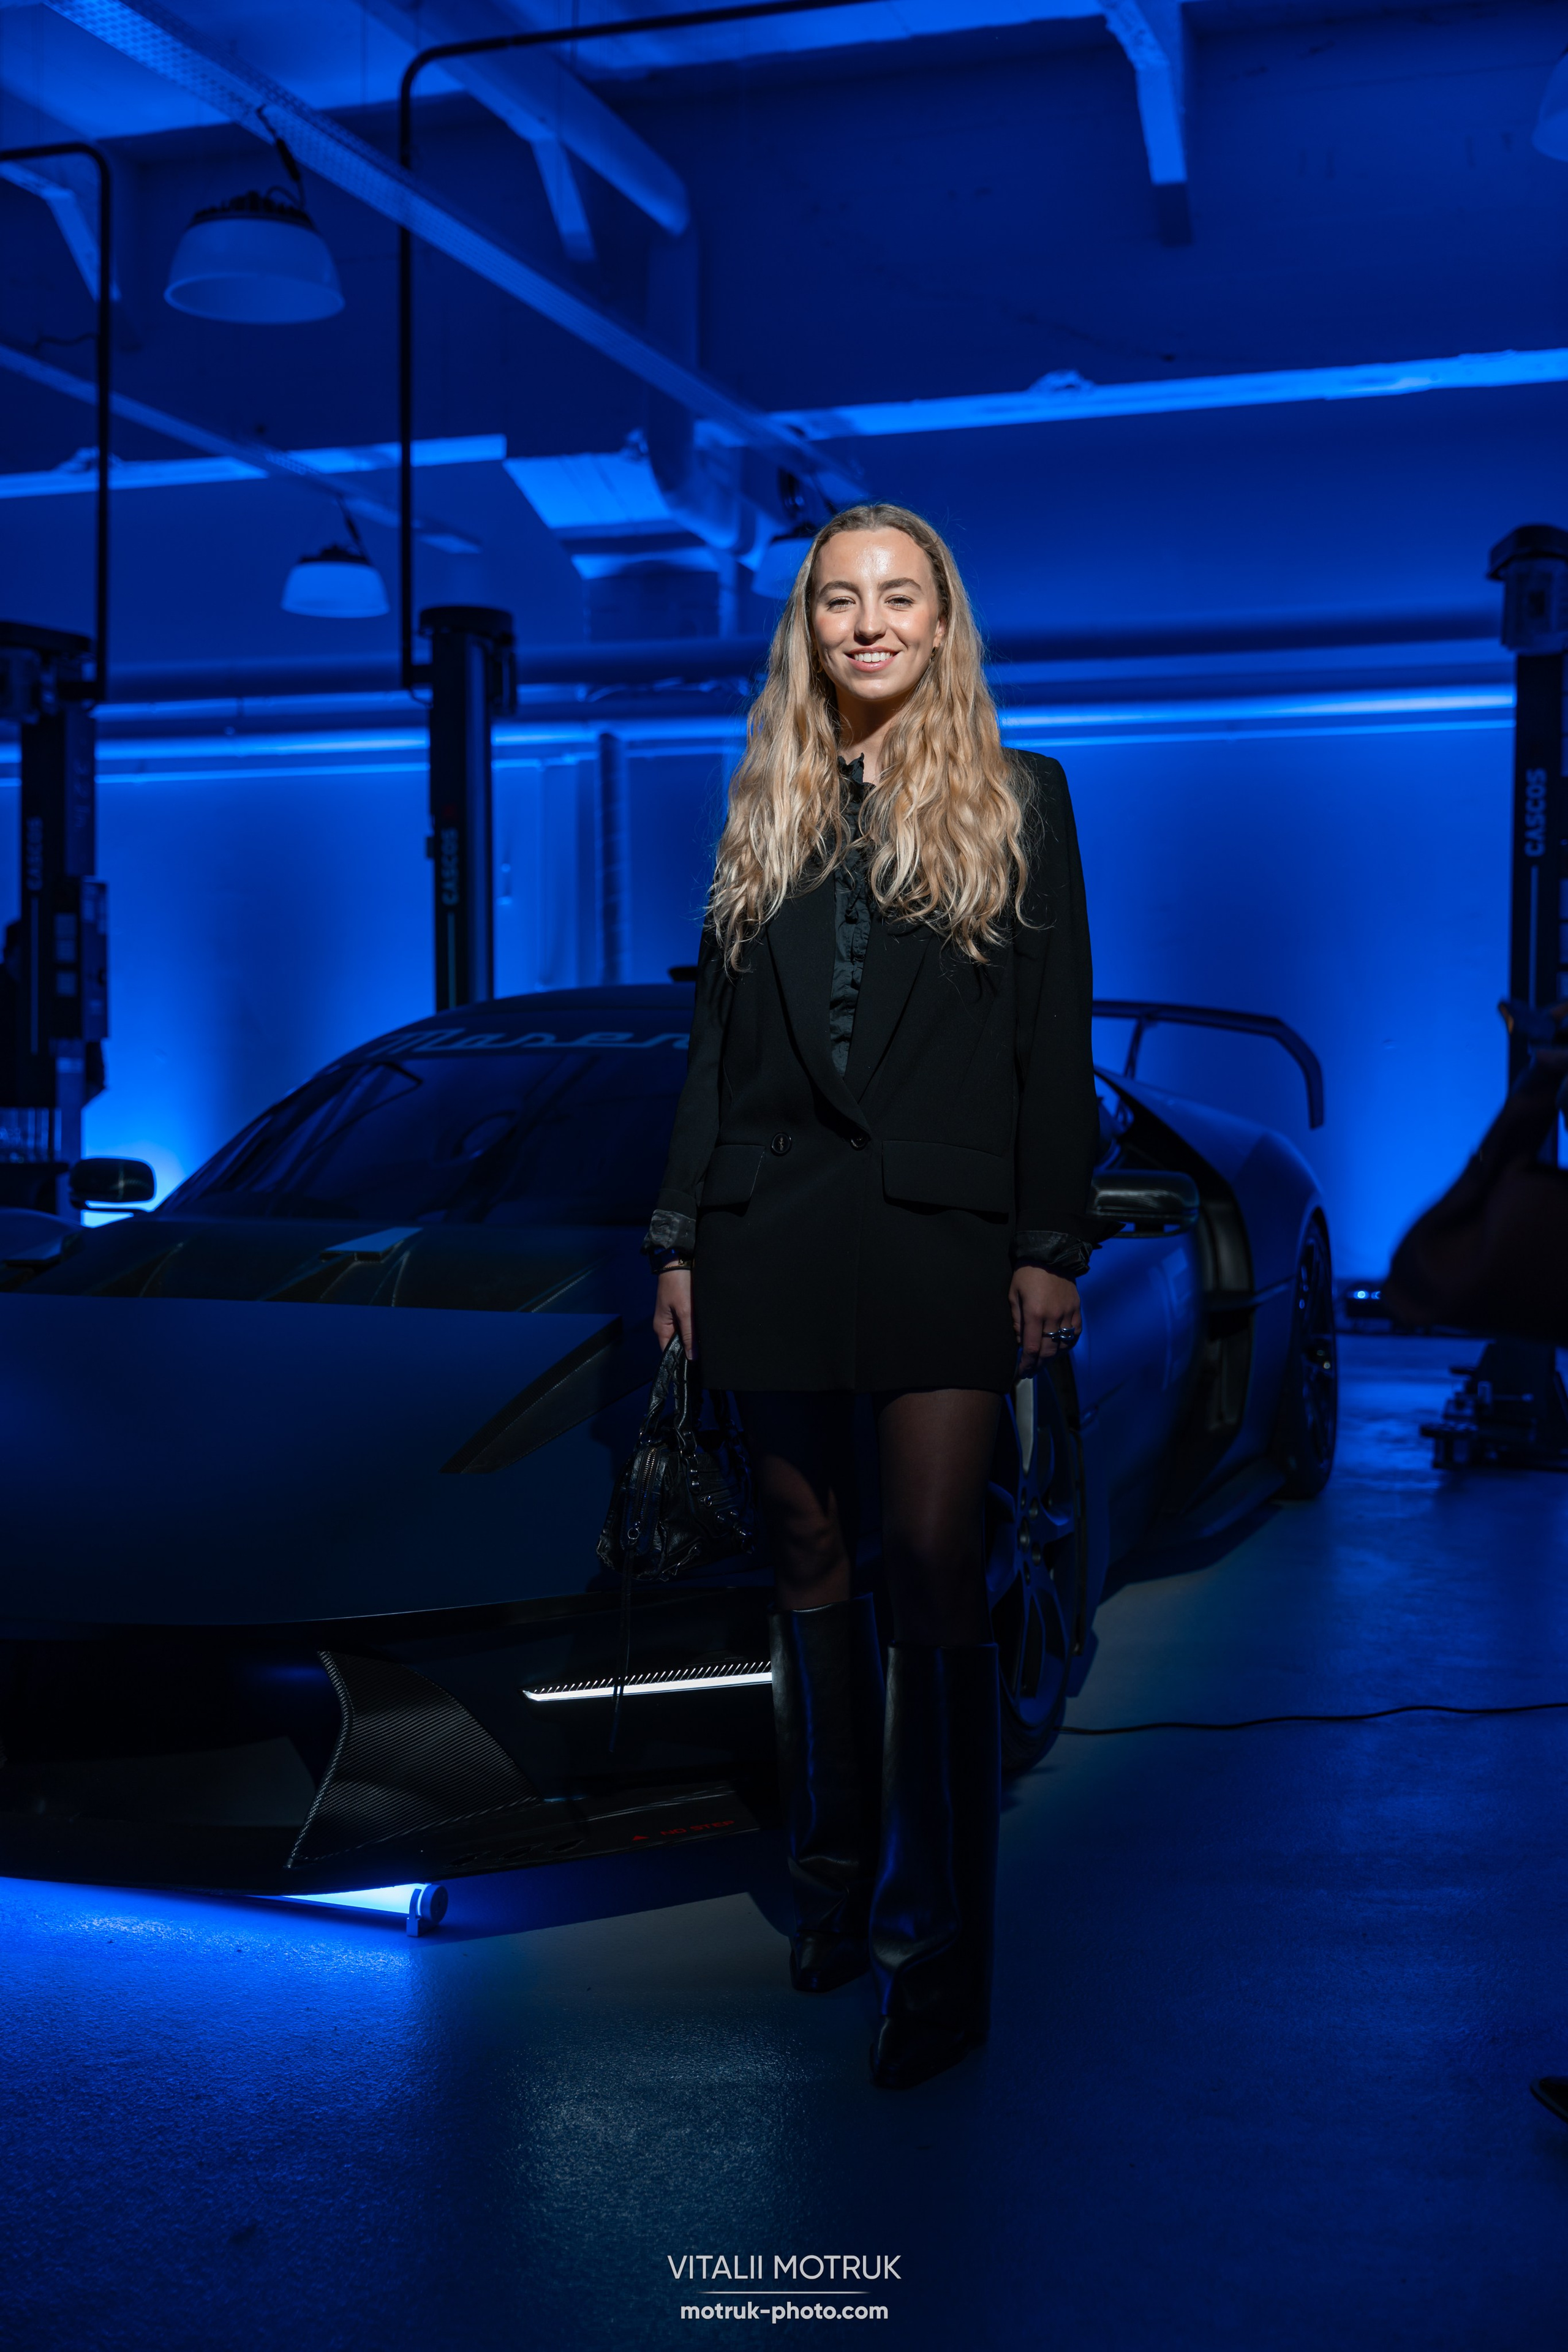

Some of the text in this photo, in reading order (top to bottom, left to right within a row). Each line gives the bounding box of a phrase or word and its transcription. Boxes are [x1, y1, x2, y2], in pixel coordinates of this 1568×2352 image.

[1525, 767, 1547, 857] CASCOS
[441, 827, 461, 905] CASCOS
[690, 1820, 734, 1830] STEP
